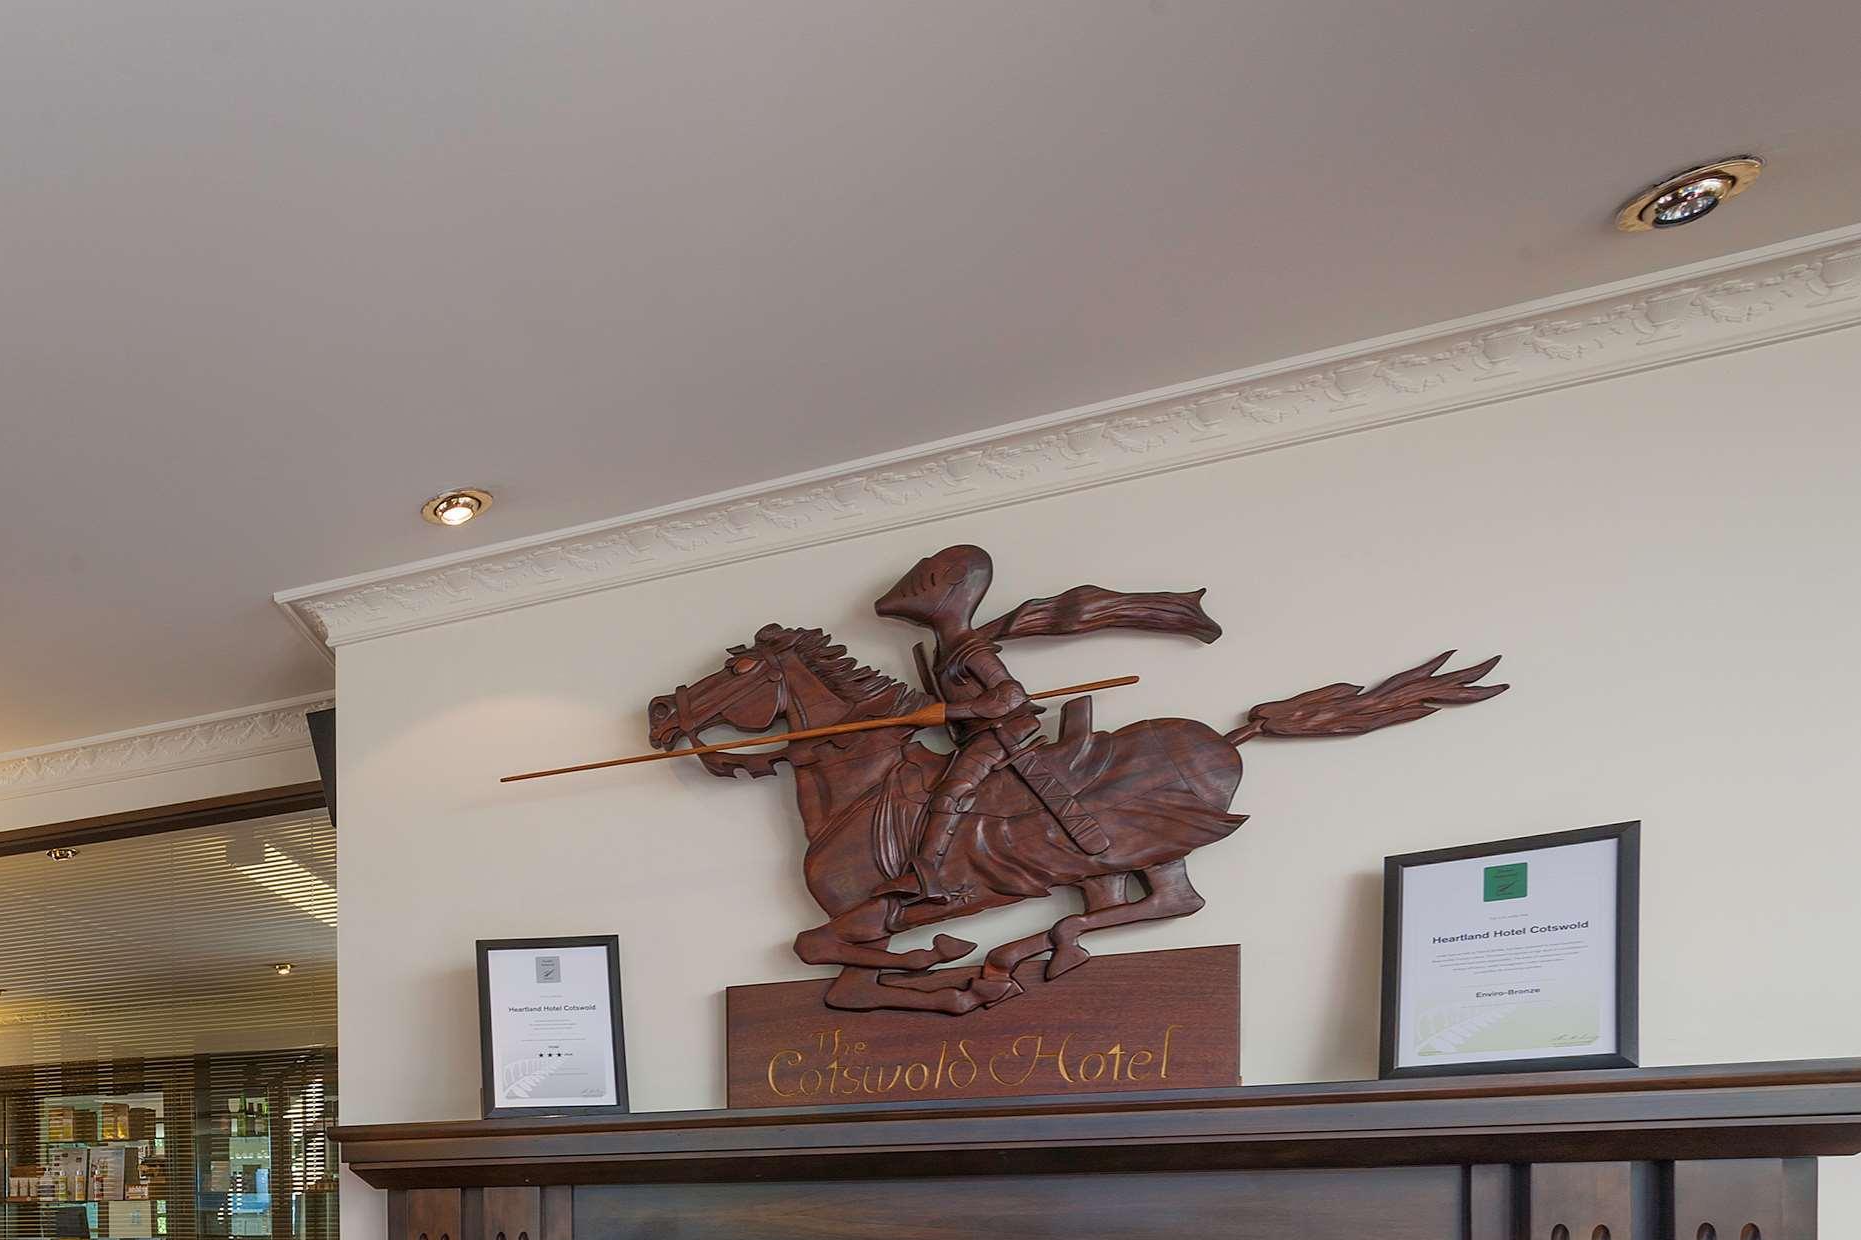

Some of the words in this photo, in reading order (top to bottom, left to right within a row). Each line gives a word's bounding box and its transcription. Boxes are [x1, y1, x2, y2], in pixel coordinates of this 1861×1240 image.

[1432, 931, 1490, 945] Heartland
[1493, 927, 1527, 938] Hotel
[1530, 921, 1589, 934] Cotswold
[1475, 987, 1541, 998] Enviro-Bronze
[508, 1005, 542, 1013] Heartland
[543, 1004, 562, 1012] Hotel
[563, 1003, 597, 1012] Cotswold
[812, 1028, 869, 1055] The
[766, 1038, 979, 1097] Cotswold
[988, 1024, 1184, 1087] Hotel
